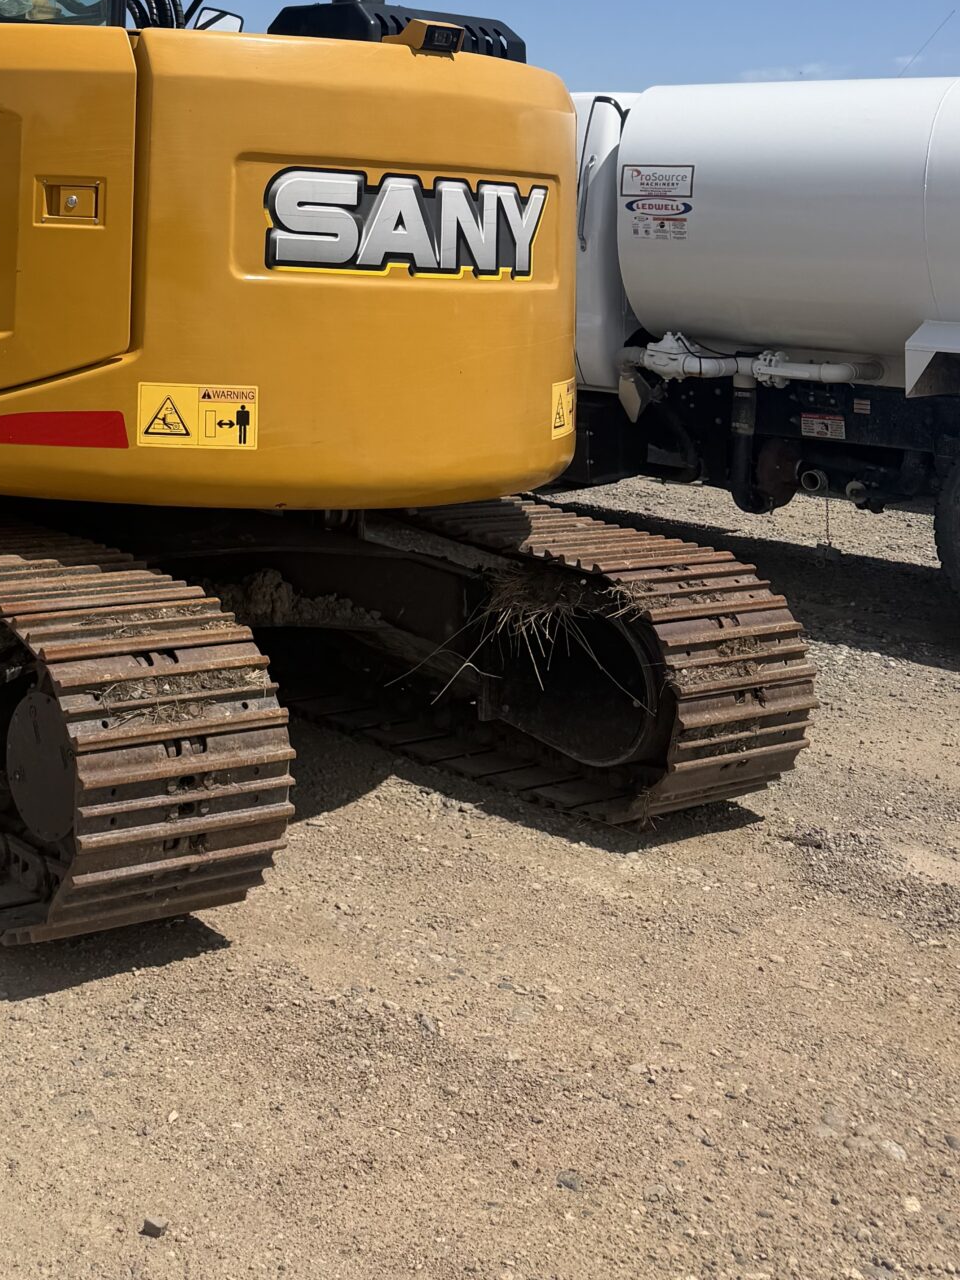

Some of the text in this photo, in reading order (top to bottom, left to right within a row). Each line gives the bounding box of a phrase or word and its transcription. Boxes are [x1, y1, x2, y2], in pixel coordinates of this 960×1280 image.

[627, 168, 687, 182] ProSource
[266, 168, 548, 276] SANY
[212, 390, 255, 401] WARNING
